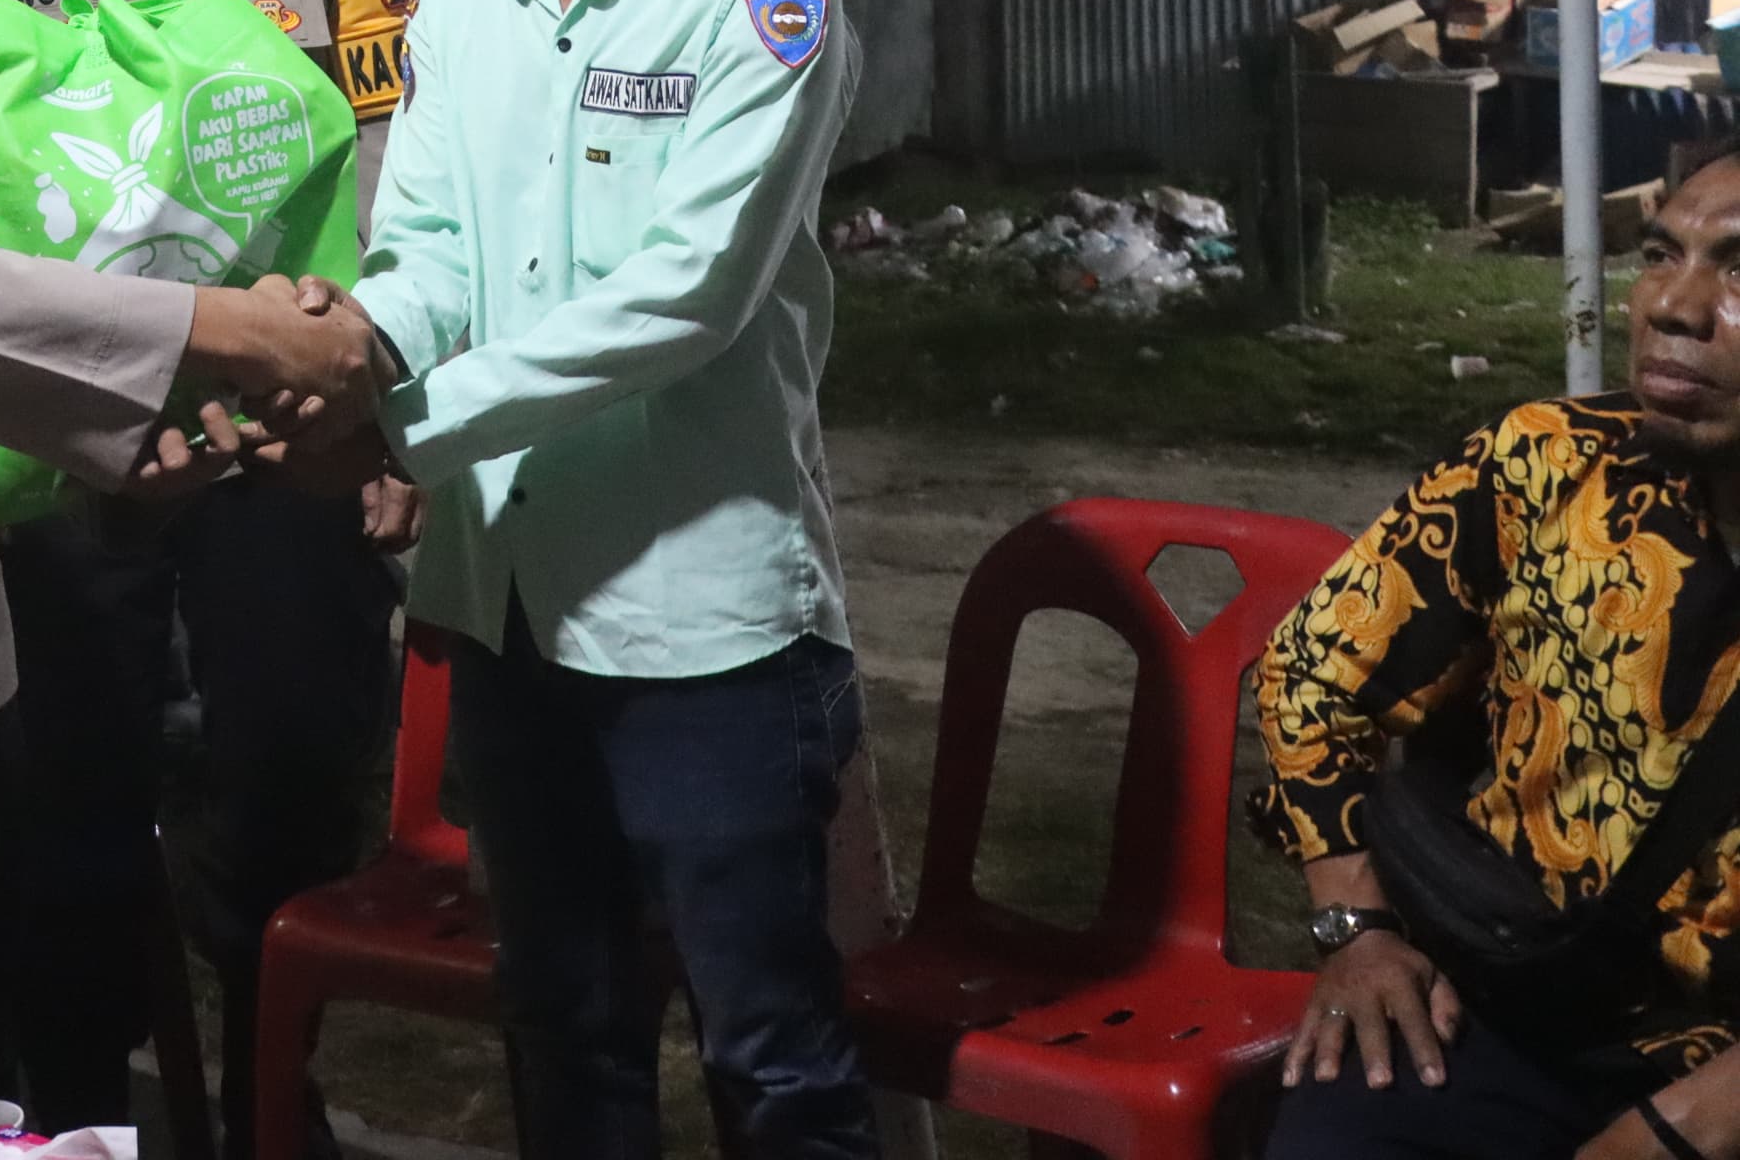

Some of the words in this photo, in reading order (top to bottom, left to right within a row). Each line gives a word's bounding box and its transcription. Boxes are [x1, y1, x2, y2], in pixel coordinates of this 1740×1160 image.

[211, 85, 268, 111] KAPAN
[587, 73, 623, 108] AWAK
[199, 117, 233, 139] AKU
[236, 98, 289, 129] BEBAS
[238, 121, 302, 153] SAMPAH
